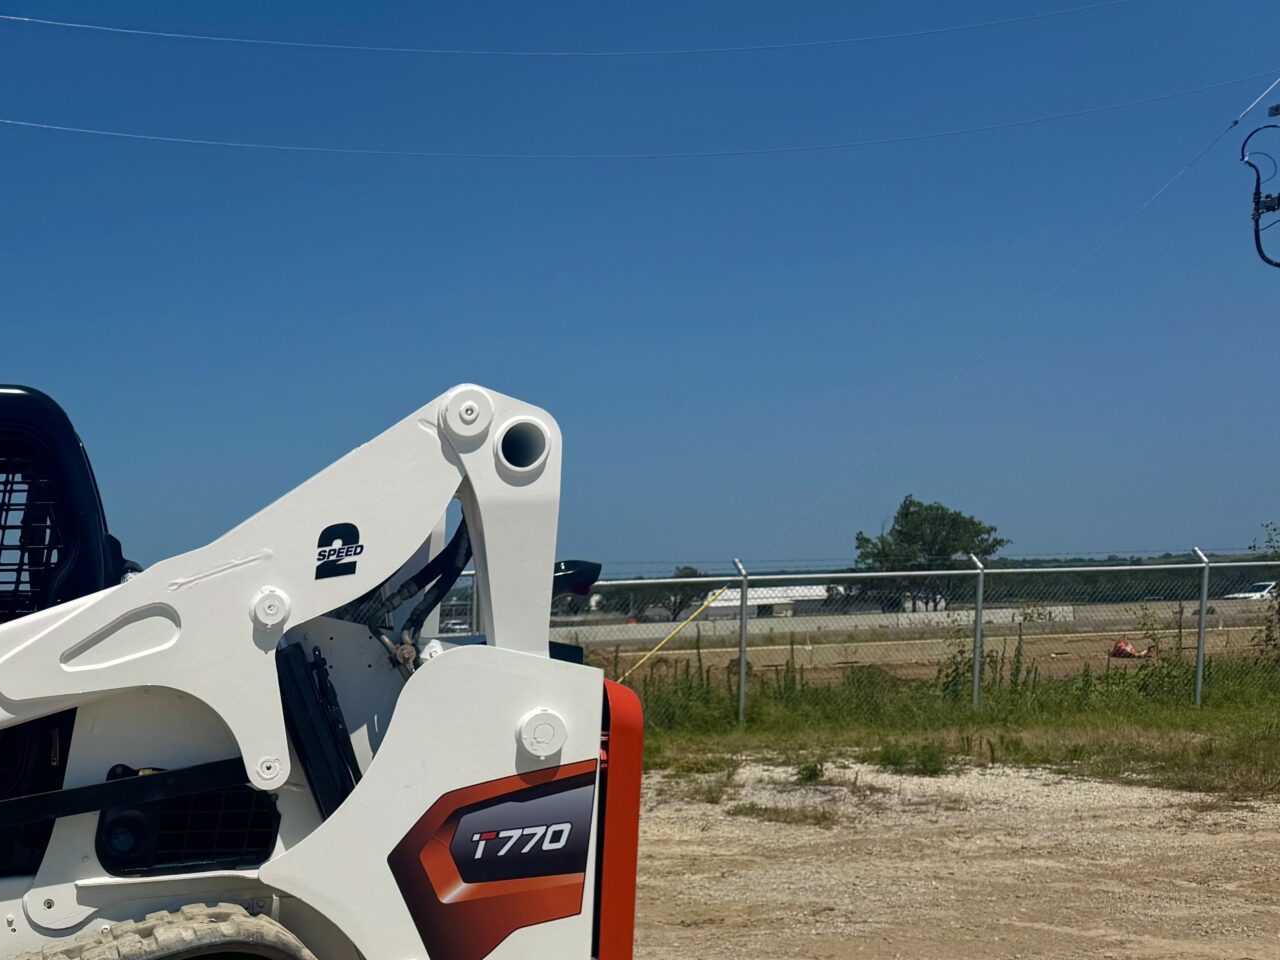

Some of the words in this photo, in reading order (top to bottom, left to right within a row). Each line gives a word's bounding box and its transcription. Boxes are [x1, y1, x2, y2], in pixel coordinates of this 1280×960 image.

[315, 522, 360, 580] 2
[316, 544, 364, 562] SPEED
[472, 822, 572, 860] T770
